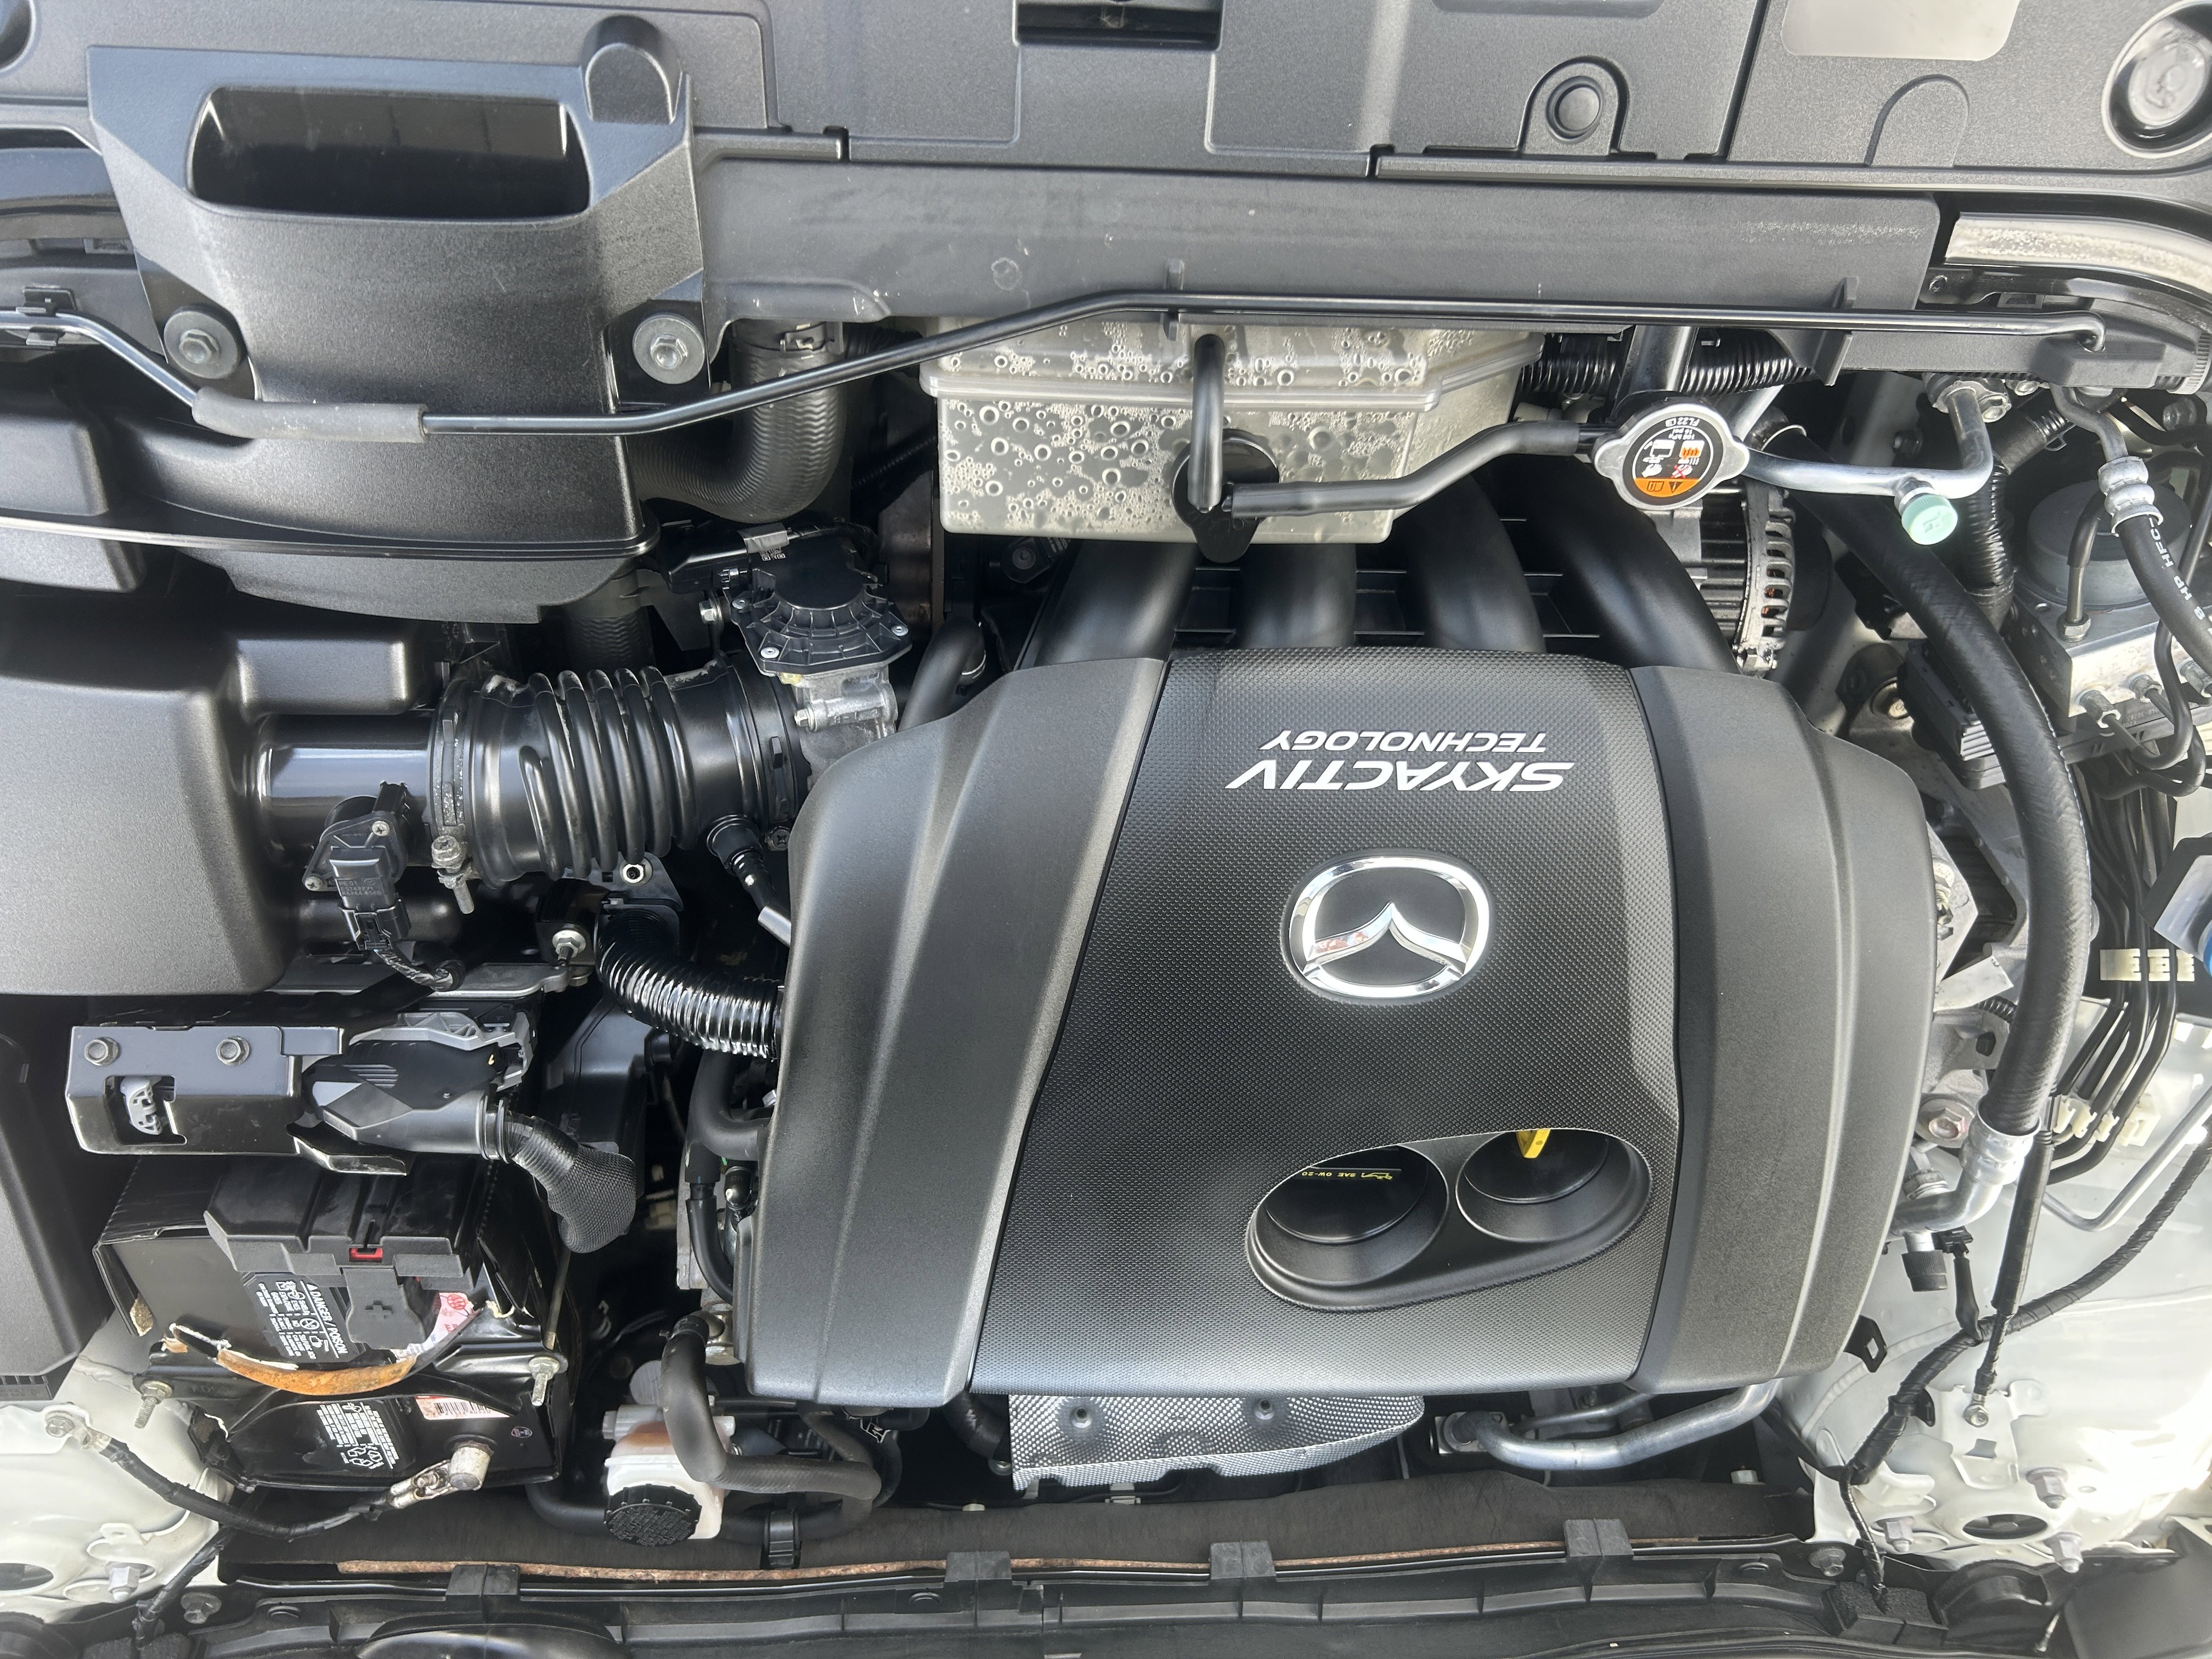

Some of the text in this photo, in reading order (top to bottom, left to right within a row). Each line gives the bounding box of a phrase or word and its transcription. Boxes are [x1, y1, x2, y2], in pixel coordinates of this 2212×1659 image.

[1678, 417, 1700, 426] FL22
[2174, 575, 2192, 601] HP
[1260, 730, 1547, 753] TECHNOLOGY
[1224, 760, 1574, 792] SKYACTIV
